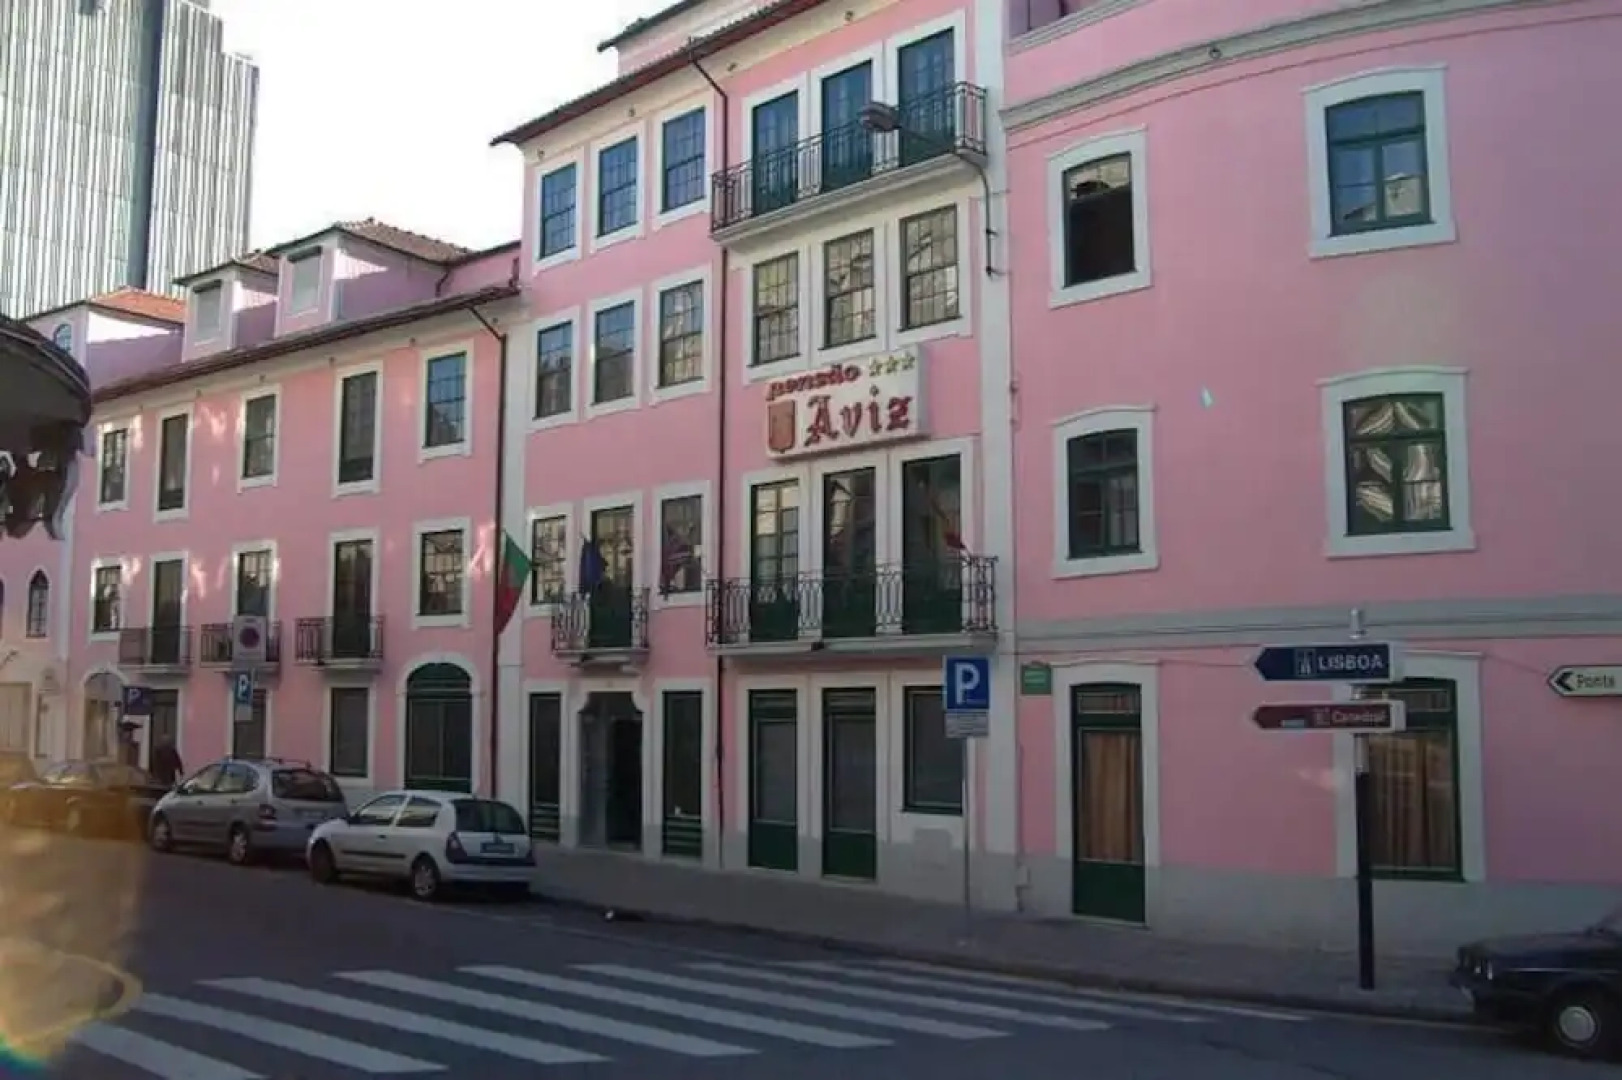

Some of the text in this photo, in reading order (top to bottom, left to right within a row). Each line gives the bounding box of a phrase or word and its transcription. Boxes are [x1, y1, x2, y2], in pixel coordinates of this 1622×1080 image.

[804, 385, 912, 446] Aviz
[955, 662, 980, 705] P
[1318, 654, 1384, 671] LISBOA
